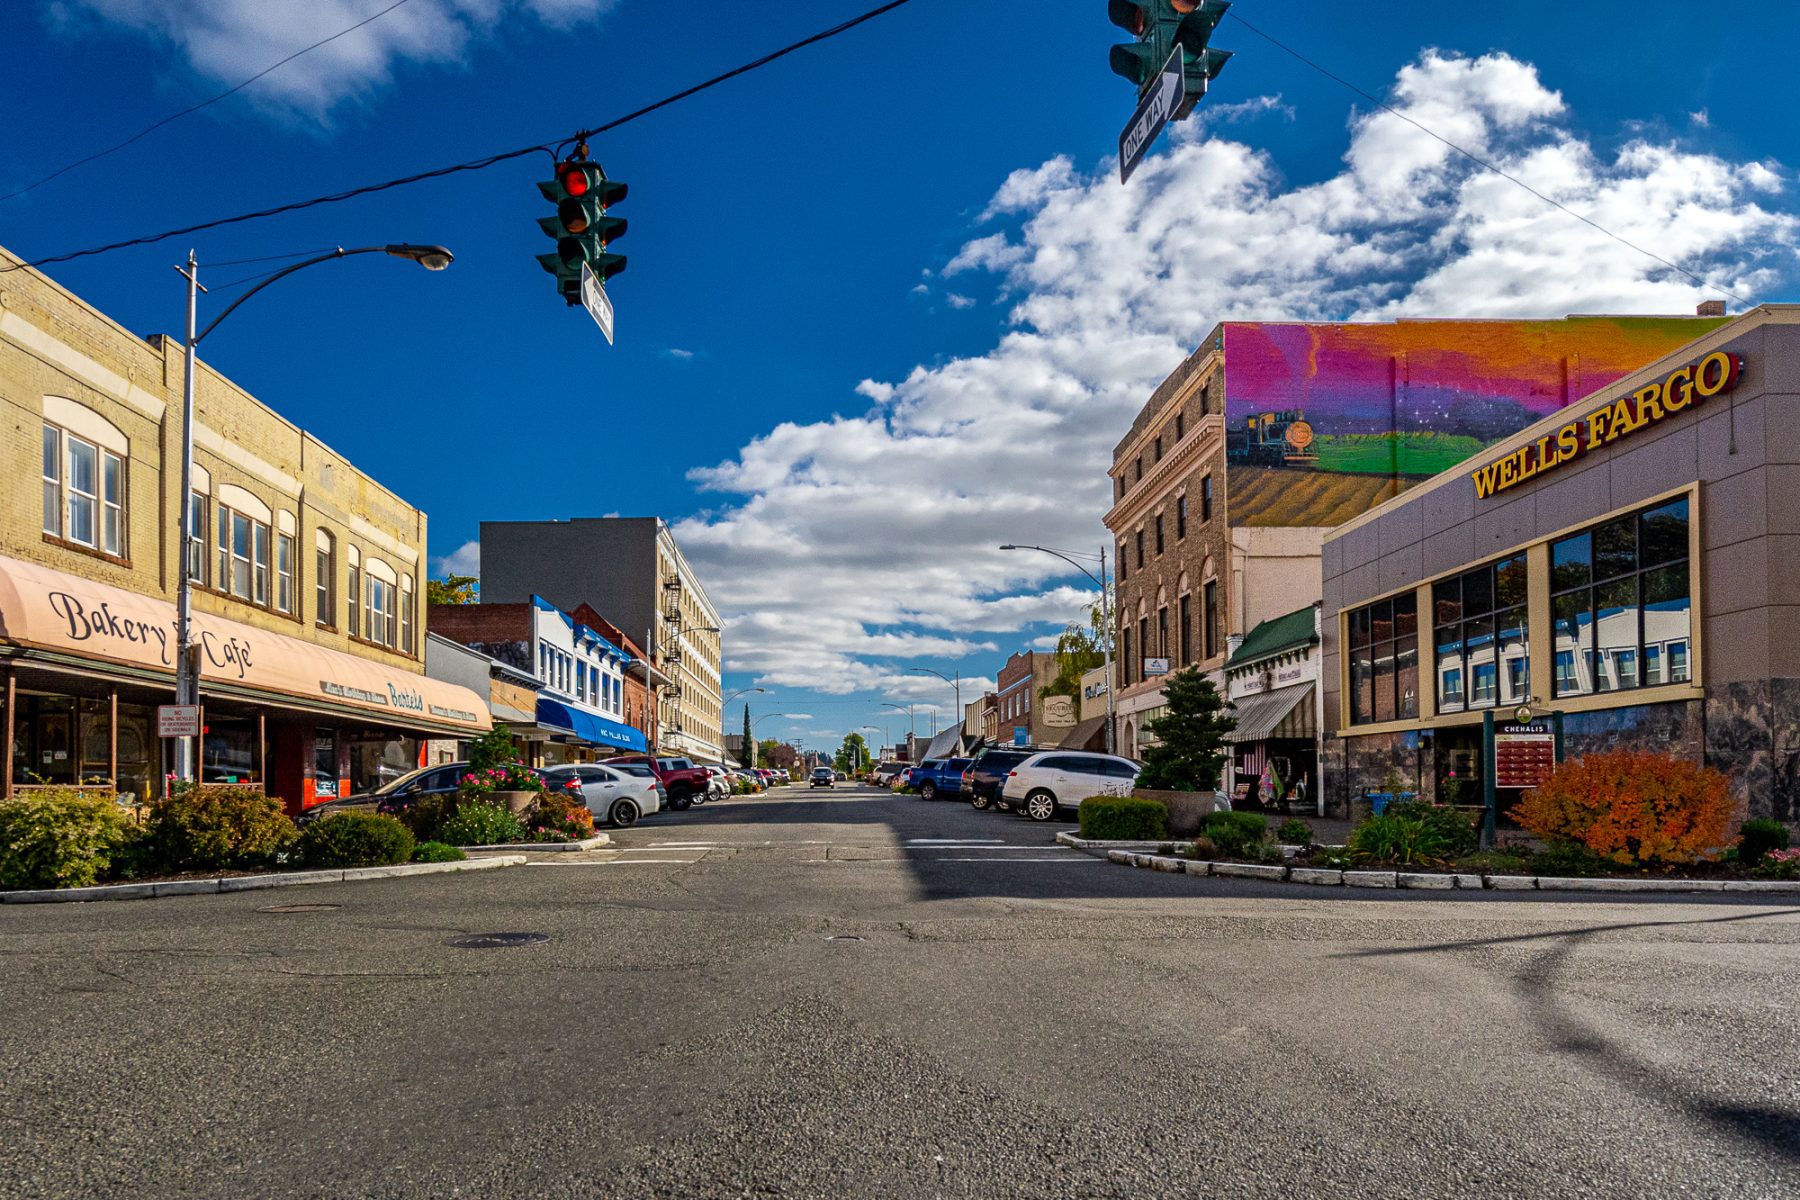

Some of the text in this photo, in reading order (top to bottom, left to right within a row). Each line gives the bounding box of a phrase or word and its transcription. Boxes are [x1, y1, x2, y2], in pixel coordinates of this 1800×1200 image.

[1126, 87, 1164, 159] ONE WAY
[1472, 351, 1735, 499] WELLS FARGO
[48, 591, 171, 665] Bakery
[201, 630, 253, 679] Café
[387, 682, 424, 712] Bartels
